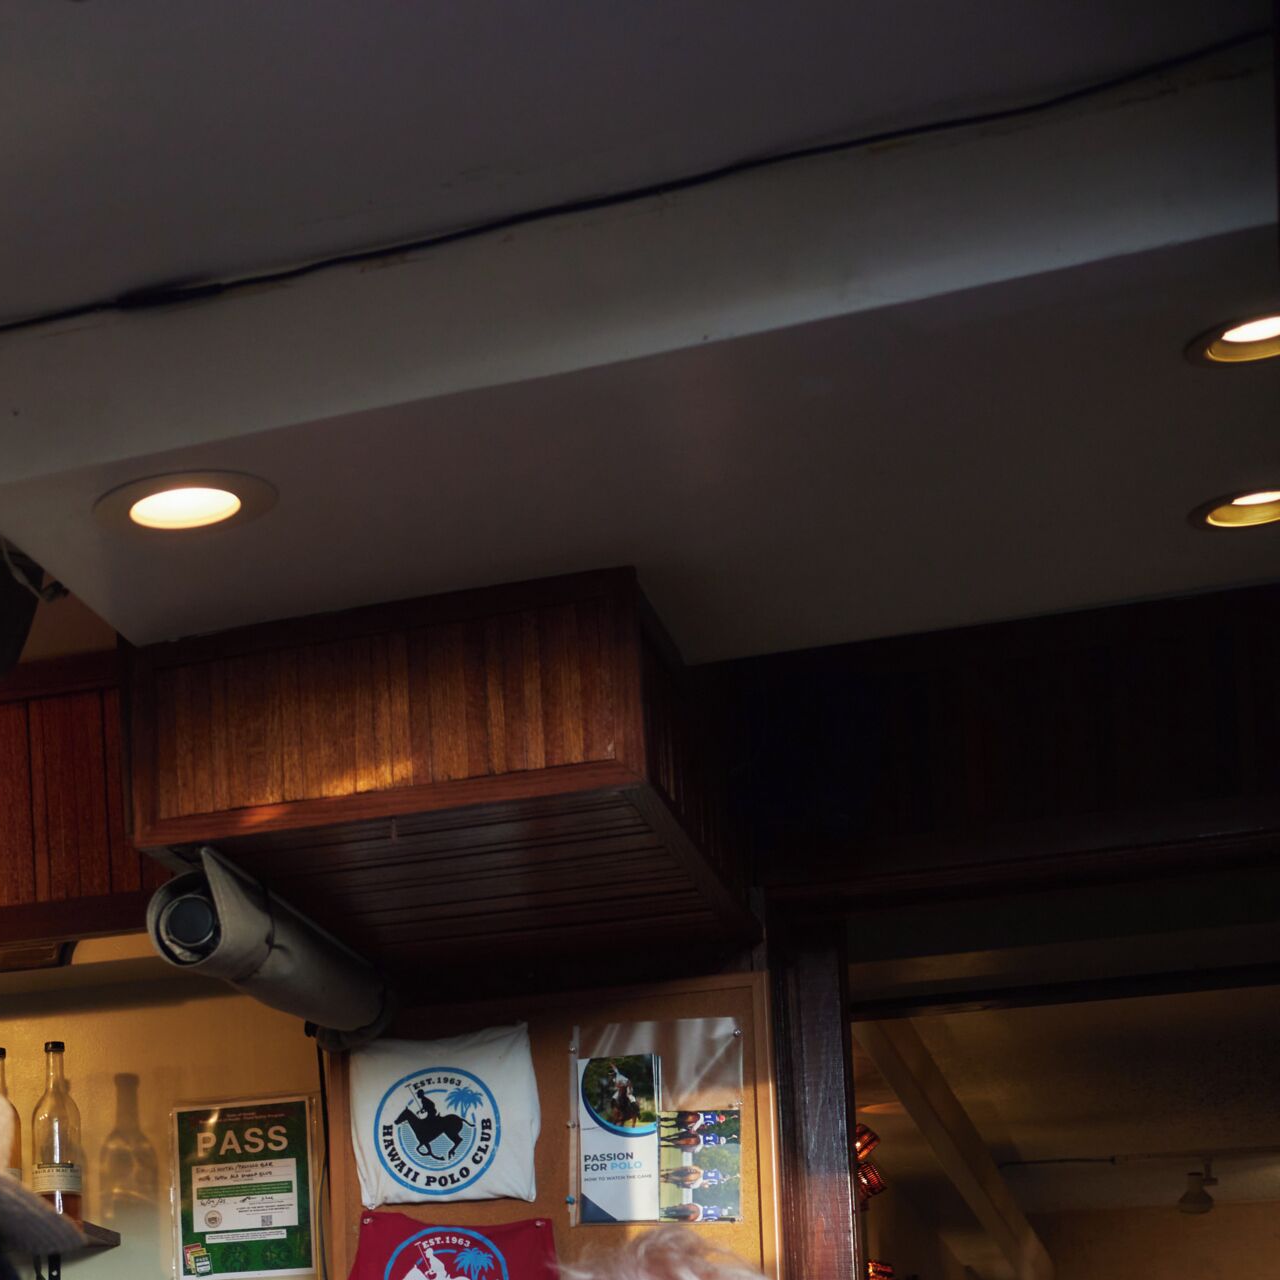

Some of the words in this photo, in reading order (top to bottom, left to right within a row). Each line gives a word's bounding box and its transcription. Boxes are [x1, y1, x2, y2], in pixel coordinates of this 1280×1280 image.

[197, 1125, 288, 1157] PASS
[382, 1124, 420, 1183] HAWAII
[425, 1166, 471, 1187] POLO
[472, 1117, 493, 1165] CLUB
[584, 1152, 634, 1163] PASSION
[584, 1163, 607, 1172] FOR
[610, 1161, 643, 1171] POLO
